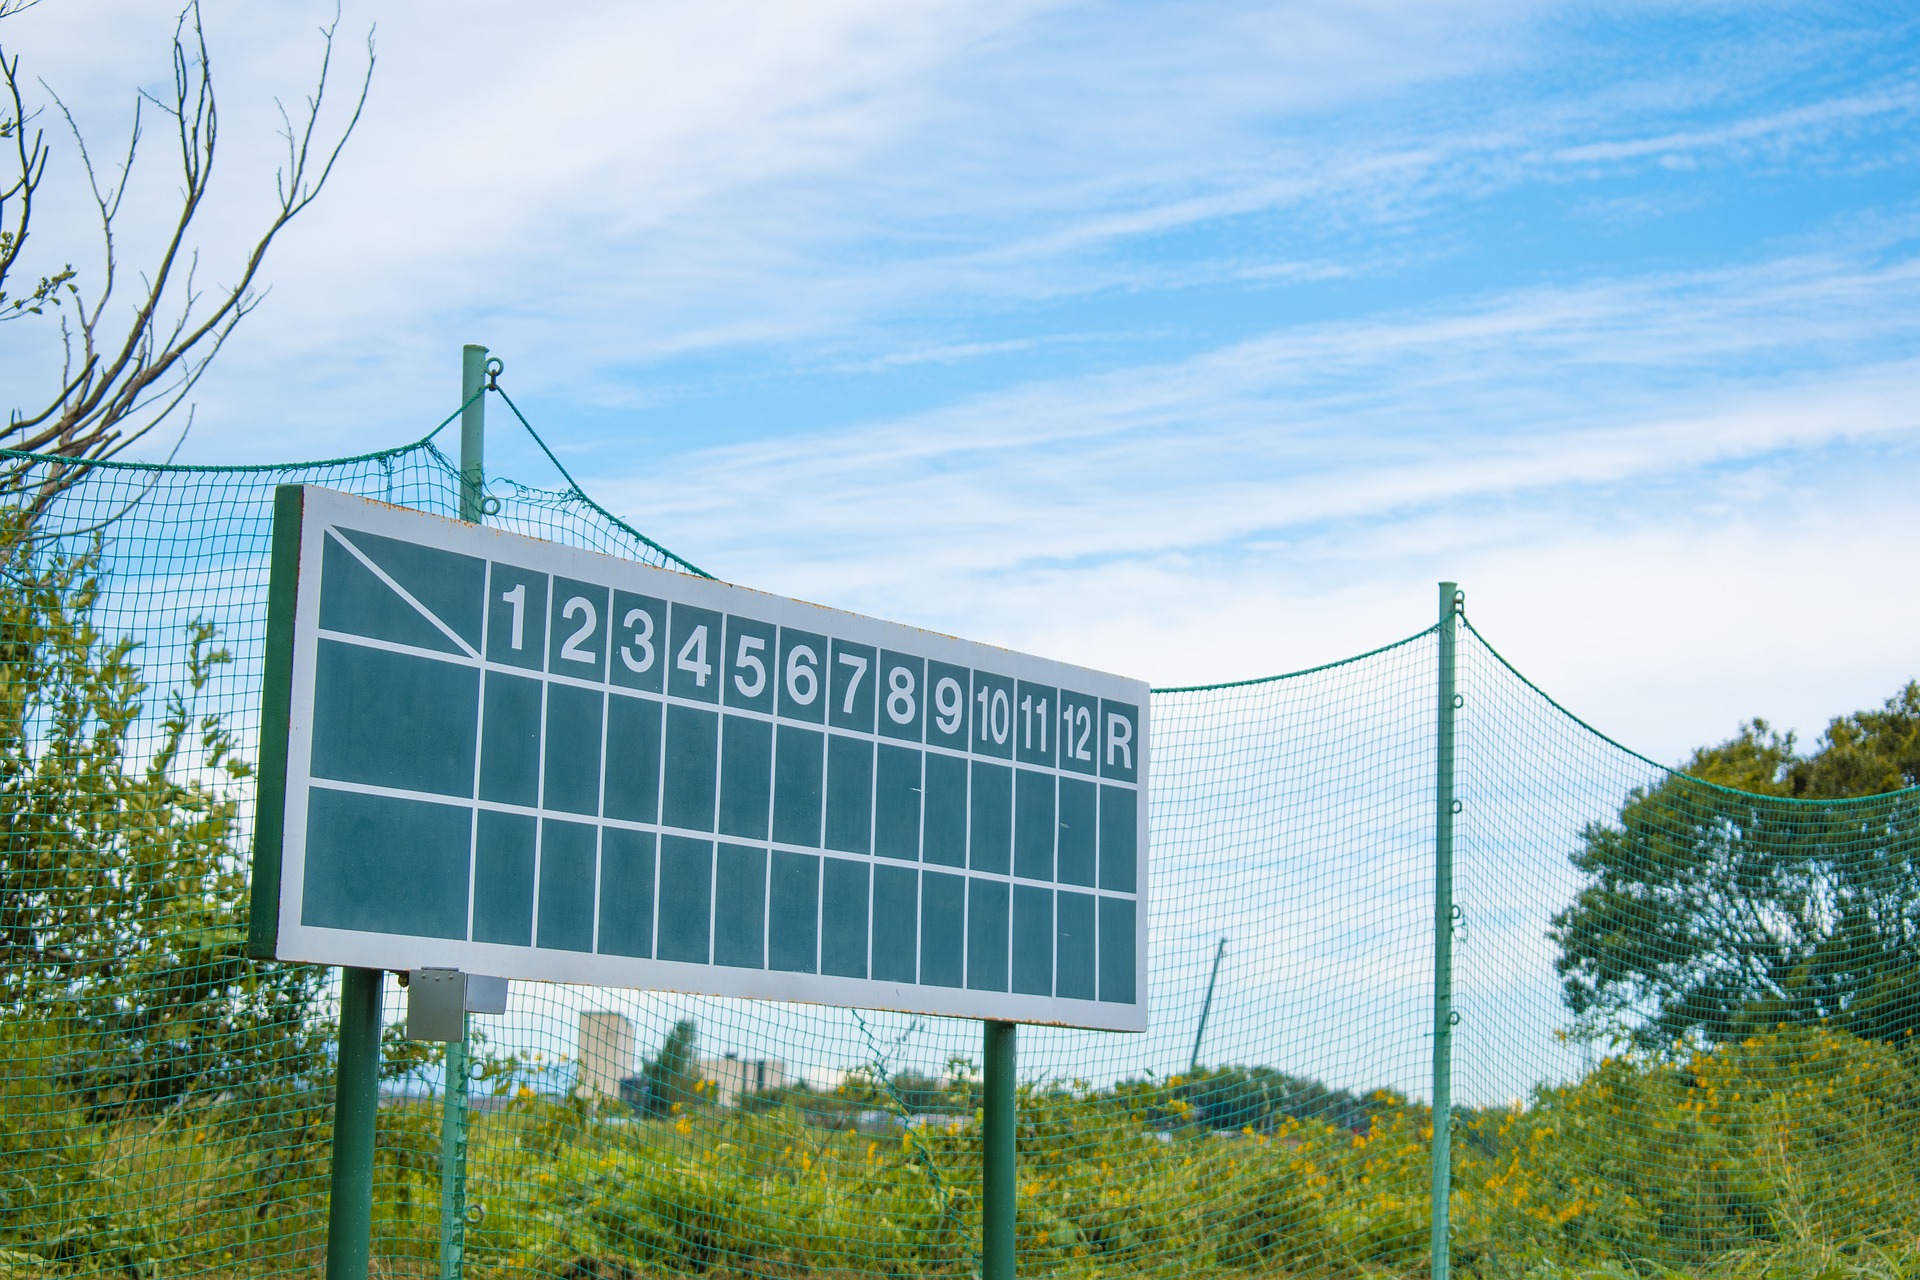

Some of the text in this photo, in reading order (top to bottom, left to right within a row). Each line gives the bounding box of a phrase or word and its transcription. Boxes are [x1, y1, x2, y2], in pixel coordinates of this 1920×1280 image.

[503, 584, 1131, 768] 1 2 3 4 5 6 7 8 9 10 11 12 R
